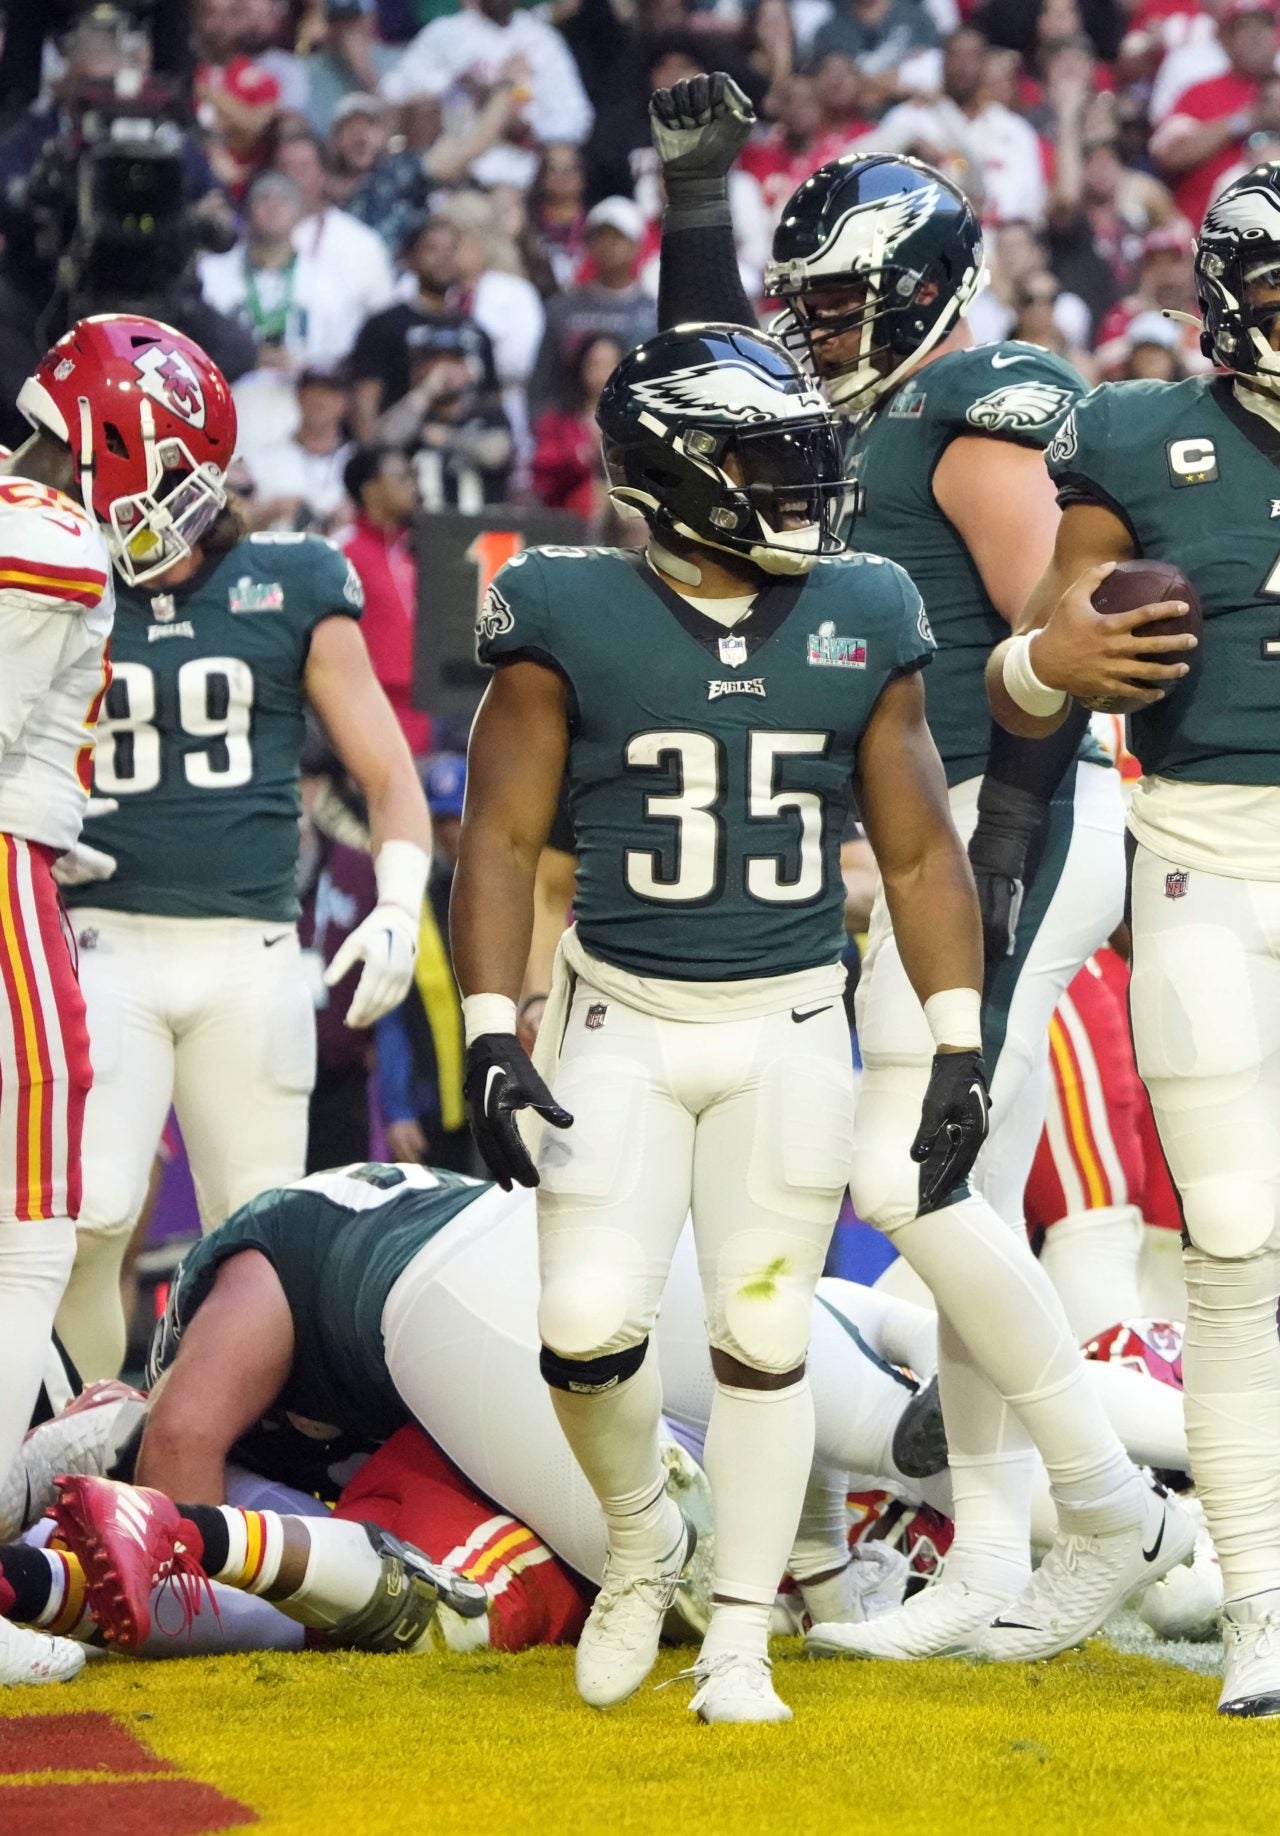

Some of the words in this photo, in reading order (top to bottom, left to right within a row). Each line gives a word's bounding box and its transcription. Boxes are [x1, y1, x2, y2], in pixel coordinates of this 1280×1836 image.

[1170, 438, 1217, 474] C
[94, 655, 254, 794] 89
[708, 677, 767, 700] EAGLES
[625, 730, 829, 902] 35
